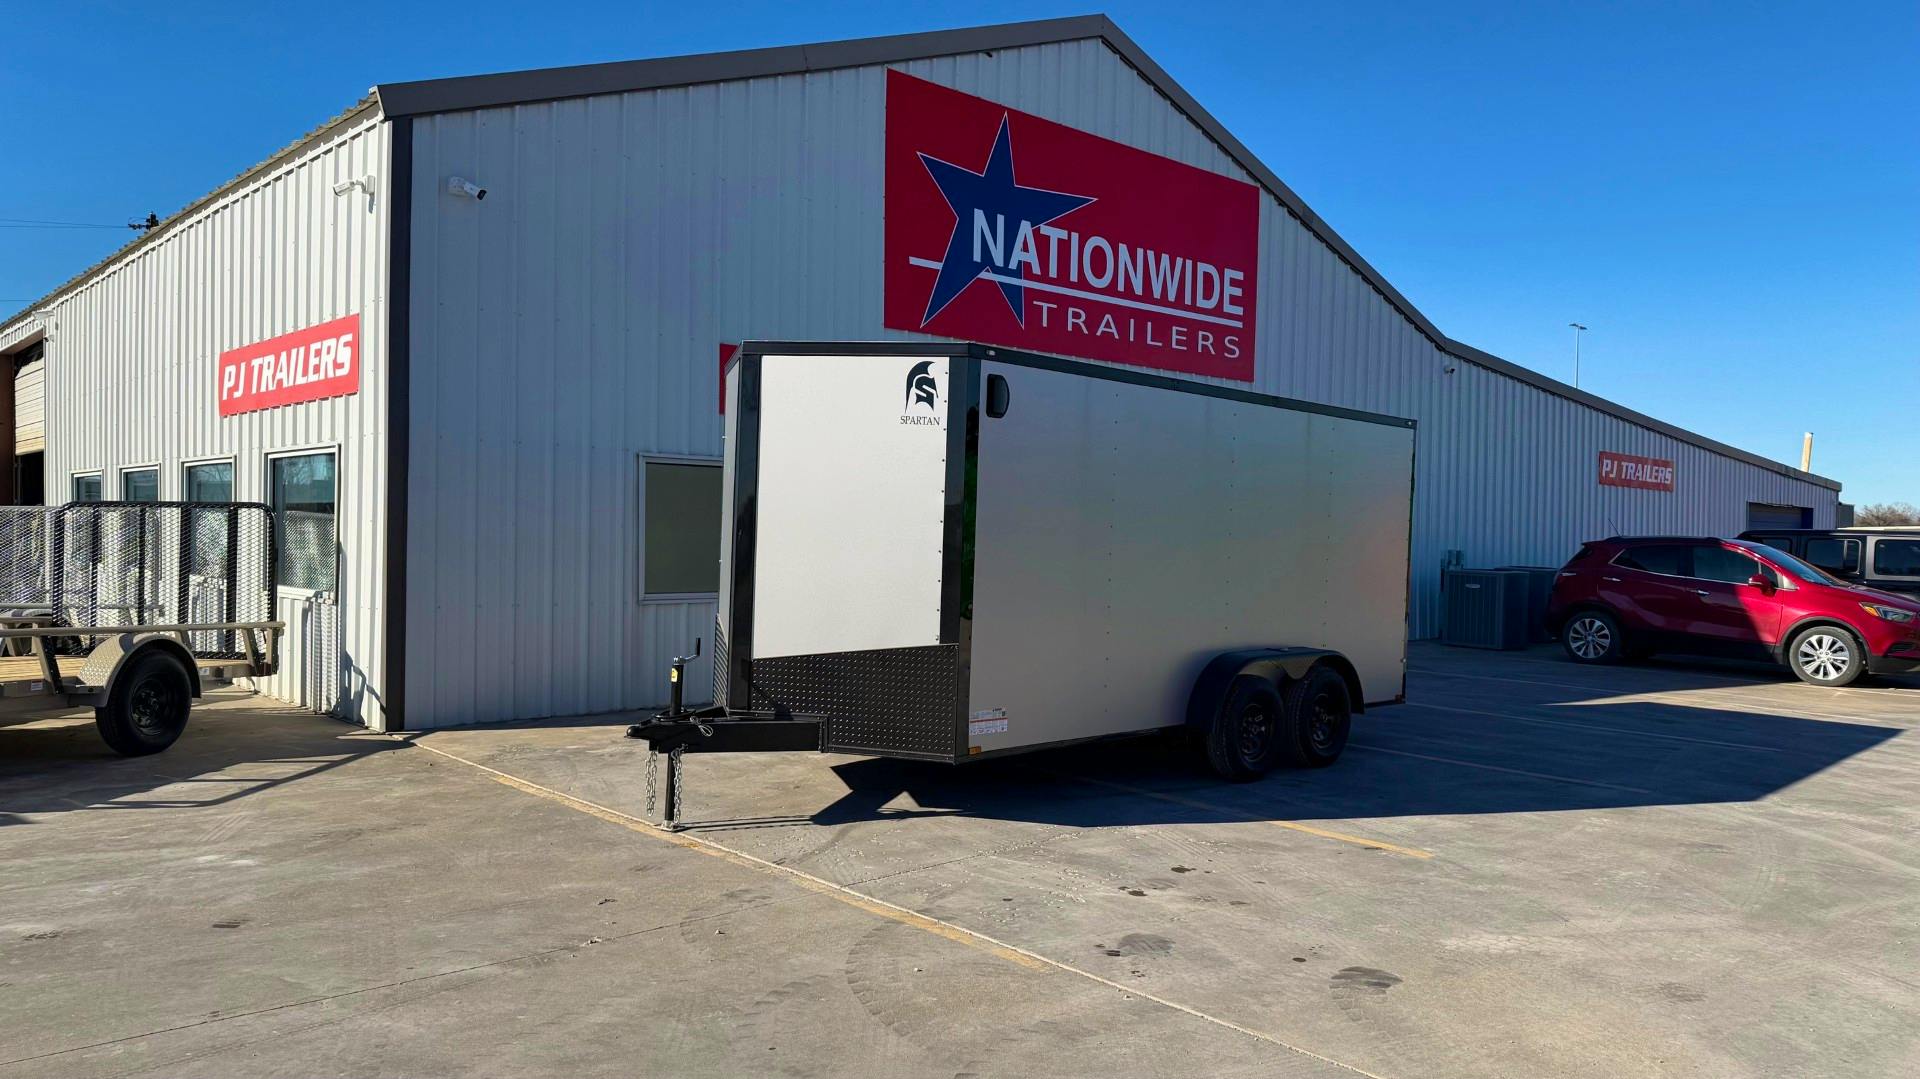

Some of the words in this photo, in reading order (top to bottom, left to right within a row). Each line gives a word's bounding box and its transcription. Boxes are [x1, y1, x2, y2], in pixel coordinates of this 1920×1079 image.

[972, 207, 1244, 316] NATIONWIDE
[1033, 300, 1240, 359] TRAILERS
[222, 361, 246, 400] PJ
[250, 333, 353, 394] TRAILERS
[900, 415, 940, 426] SPARTAN
[1602, 458, 1618, 478] PJ
[1621, 461, 1672, 484] TRAILERS
